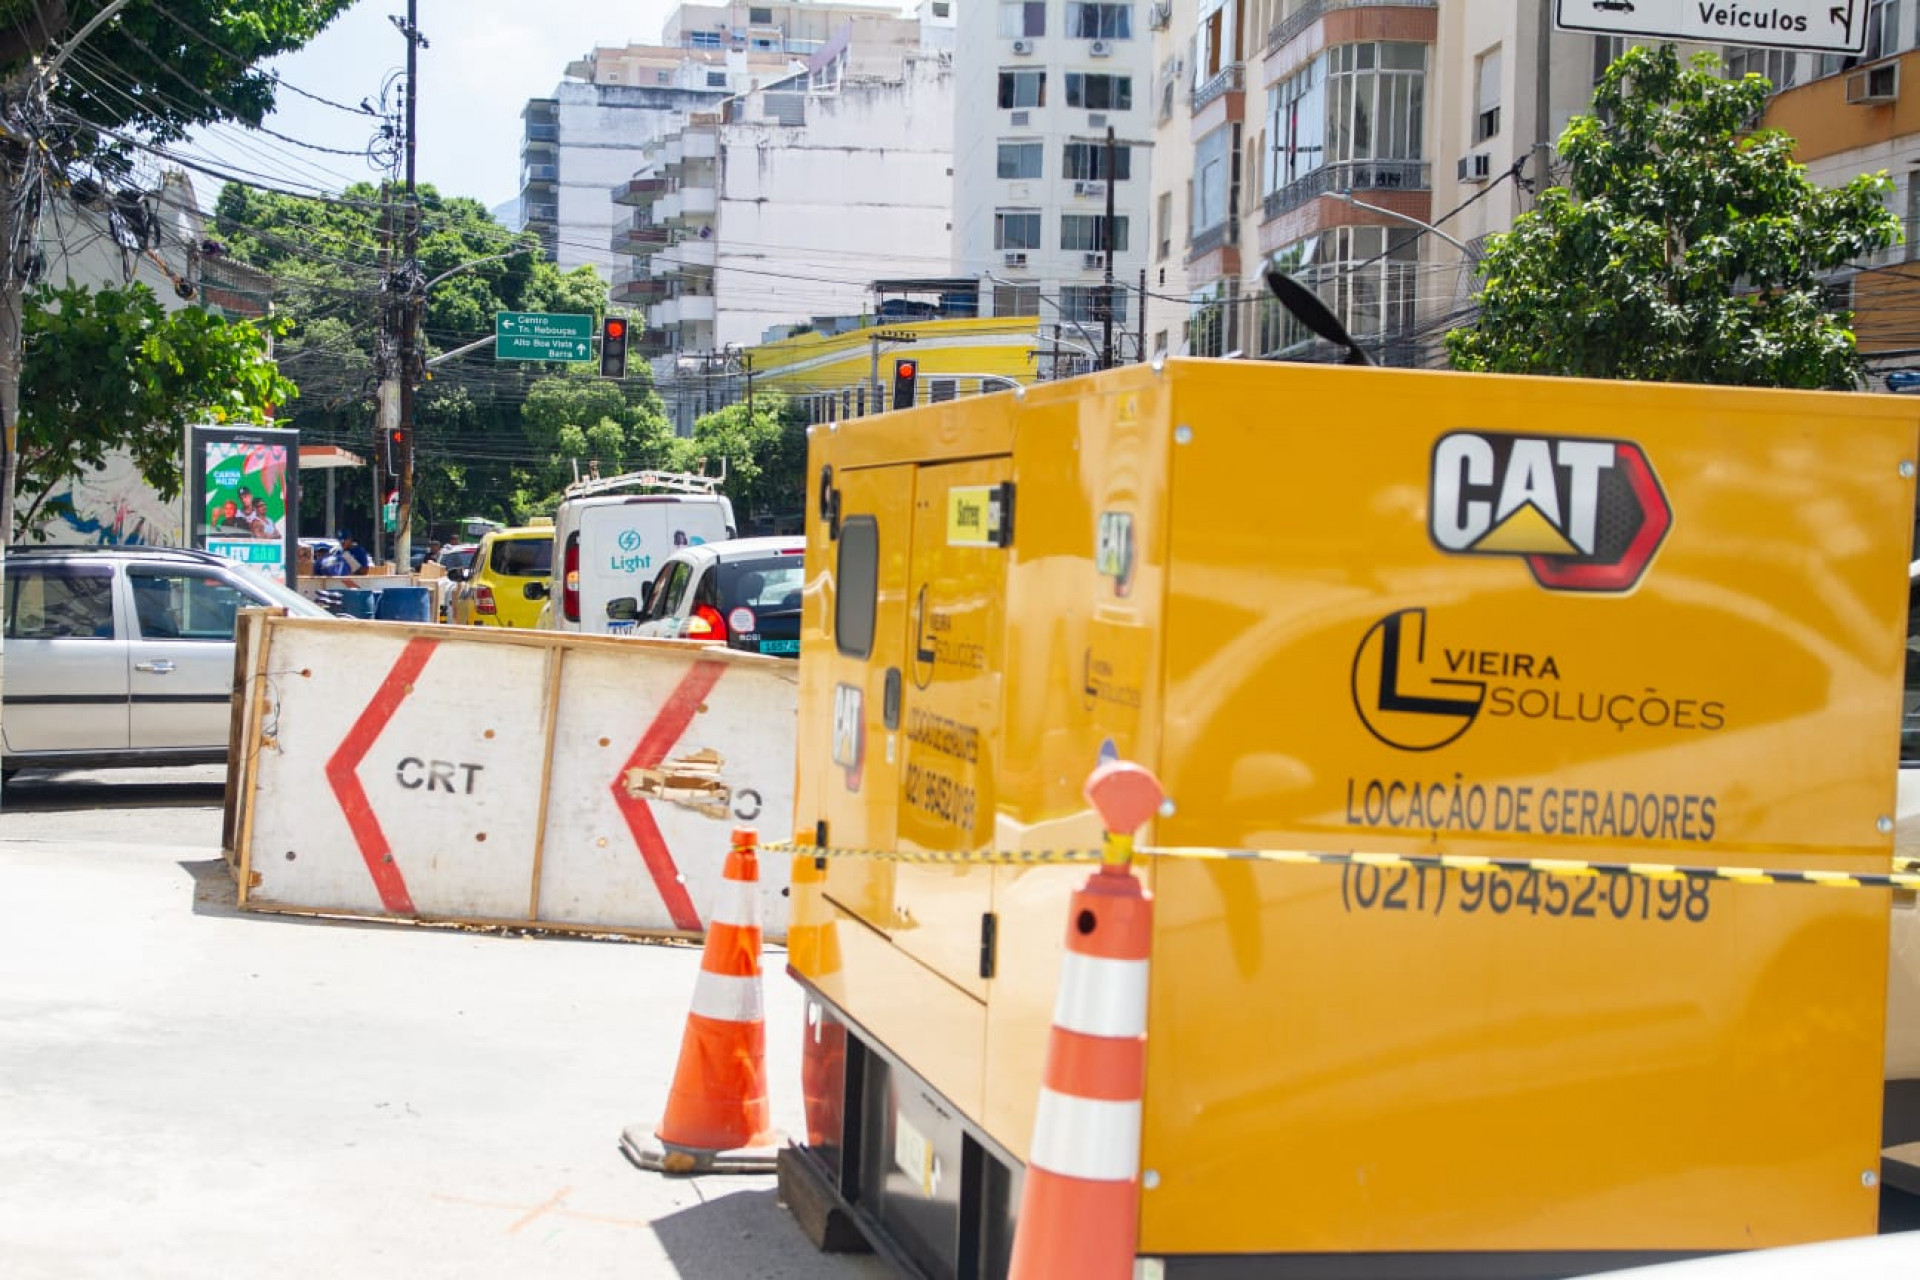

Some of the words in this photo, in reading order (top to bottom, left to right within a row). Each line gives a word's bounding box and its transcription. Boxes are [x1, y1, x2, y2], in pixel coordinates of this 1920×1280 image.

[1698, 2, 1807, 31] Veículos
[518, 315, 548, 324] Centro
[534, 326, 577, 337] Rebouças
[513, 338, 531, 347] Alto
[532, 339, 551, 348] Boa
[552, 340, 573, 349] Vista
[548, 349, 573, 358] Barra
[1433, 433, 1615, 556] CAT
[611, 554, 650, 573] Light
[1444, 648, 1561, 680] VIEIRA
[1488, 686, 1726, 732] SOLUÇÕES
[396, 756, 484, 795] CRT
[1346, 772, 1487, 843] LOCAÇÃO
[1495, 785, 1534, 832] DE
[1539, 787, 1718, 842] GERADORES
[1342, 850, 1447, 915] (021)
[1459, 866, 1711, 923] 96452-0198
